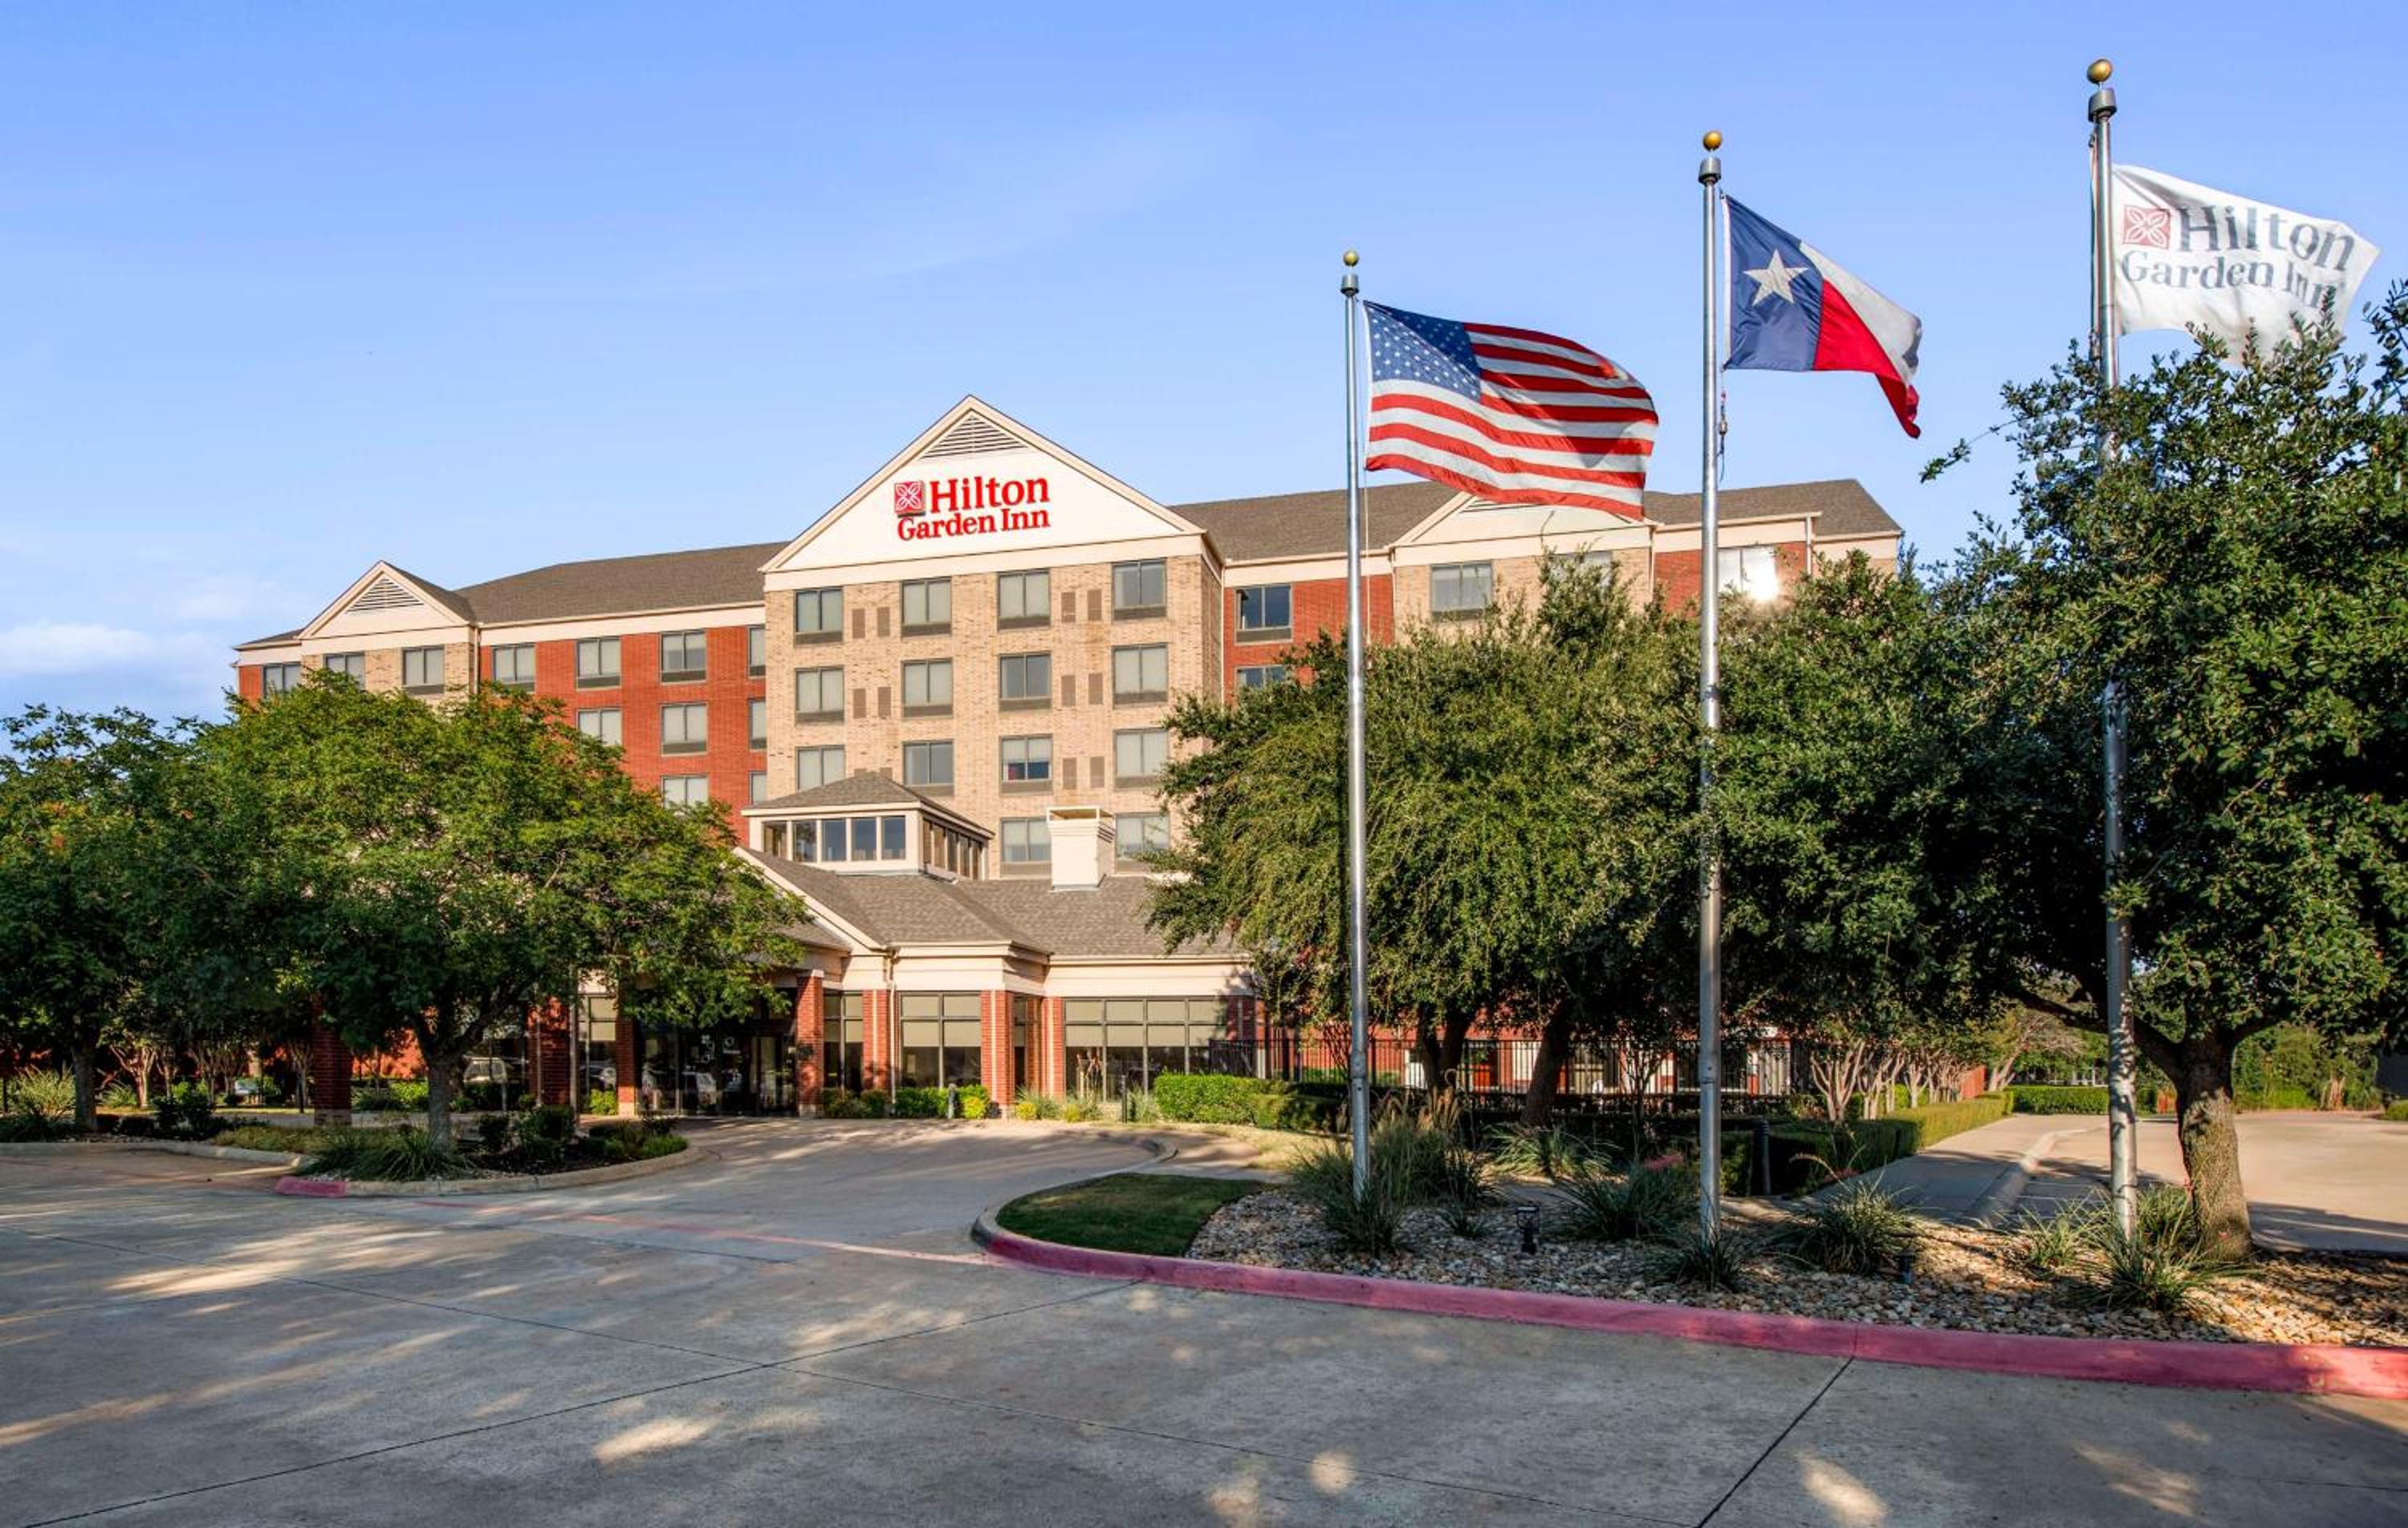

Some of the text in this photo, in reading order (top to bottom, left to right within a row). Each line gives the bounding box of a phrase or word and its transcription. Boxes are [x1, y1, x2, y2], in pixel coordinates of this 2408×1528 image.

[2178, 205, 2355, 271] Hilton
[2121, 250, 2273, 289] Garden
[929, 476, 1050, 514] Hilton
[897, 508, 1050, 541] Garden Inn
